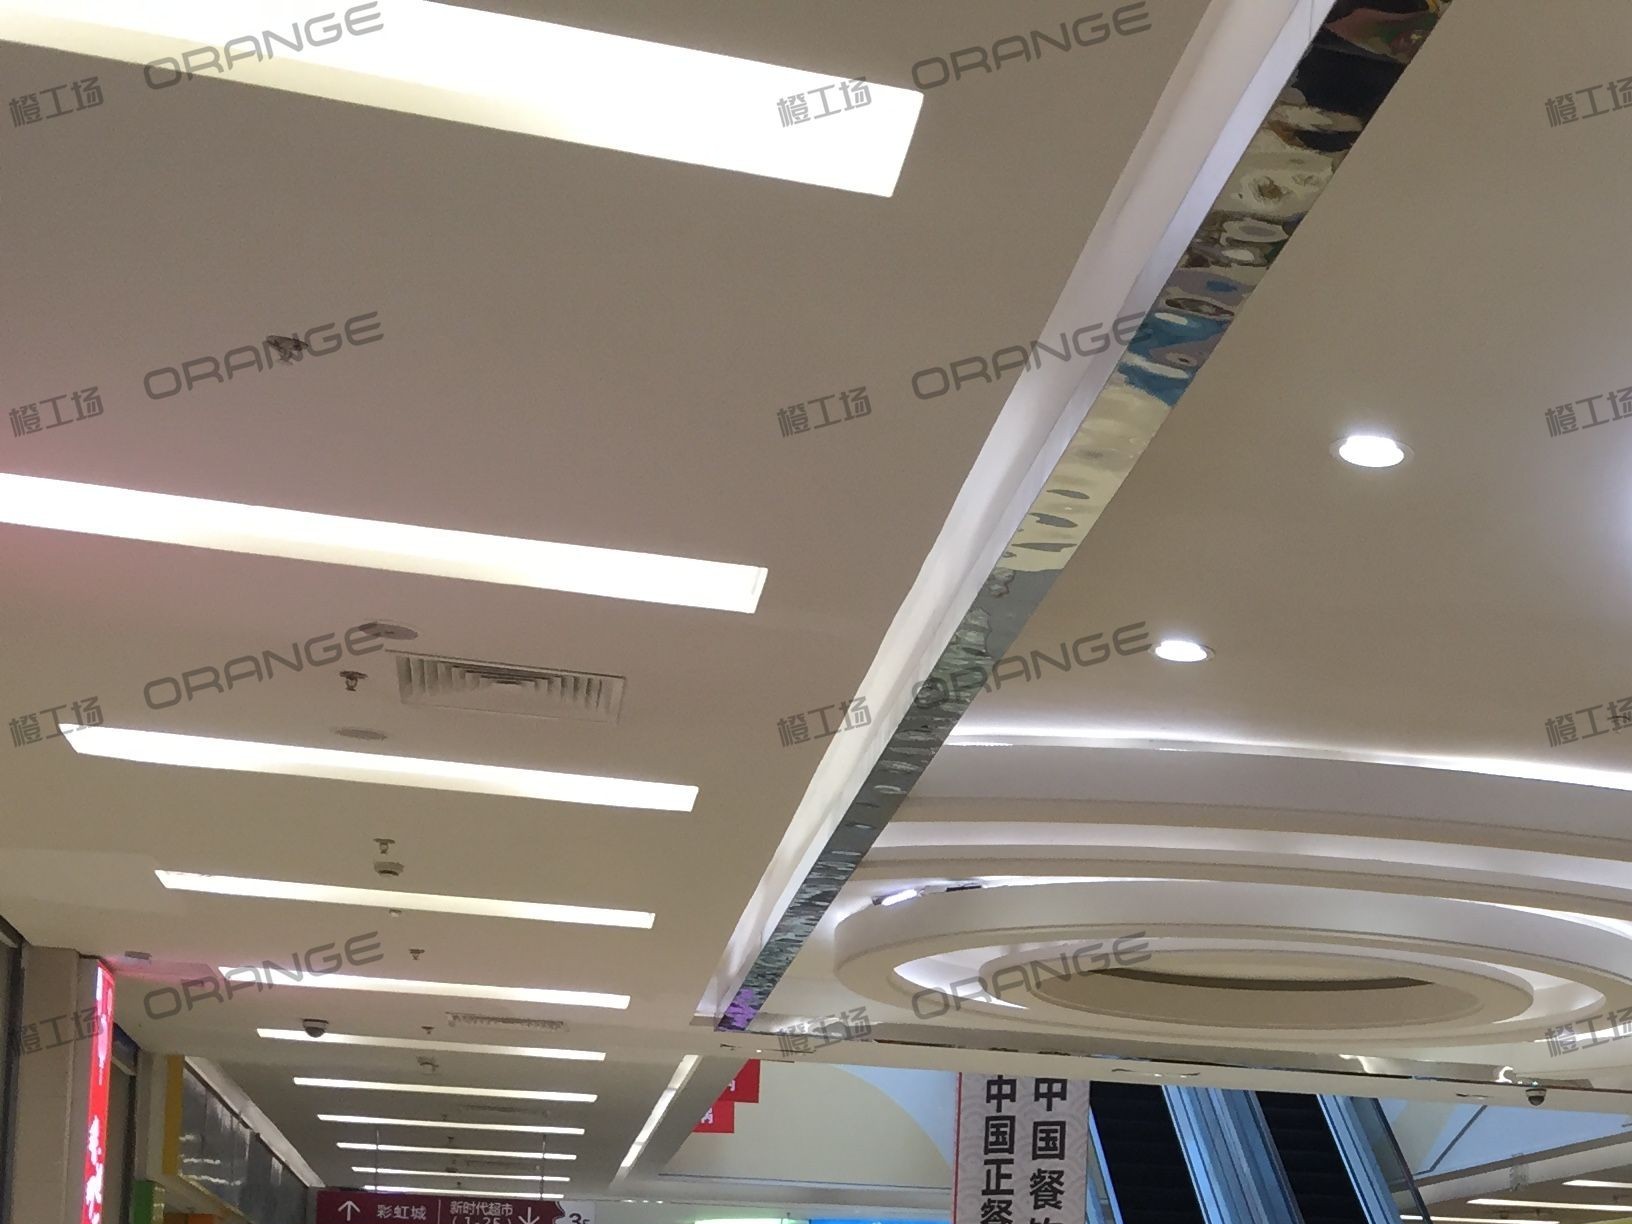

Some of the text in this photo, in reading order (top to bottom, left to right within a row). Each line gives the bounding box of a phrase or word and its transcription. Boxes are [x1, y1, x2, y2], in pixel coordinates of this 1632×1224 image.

[377, 1203, 428, 1221] 彩虹城
[450, 1200, 514, 1217] 新时代超市
